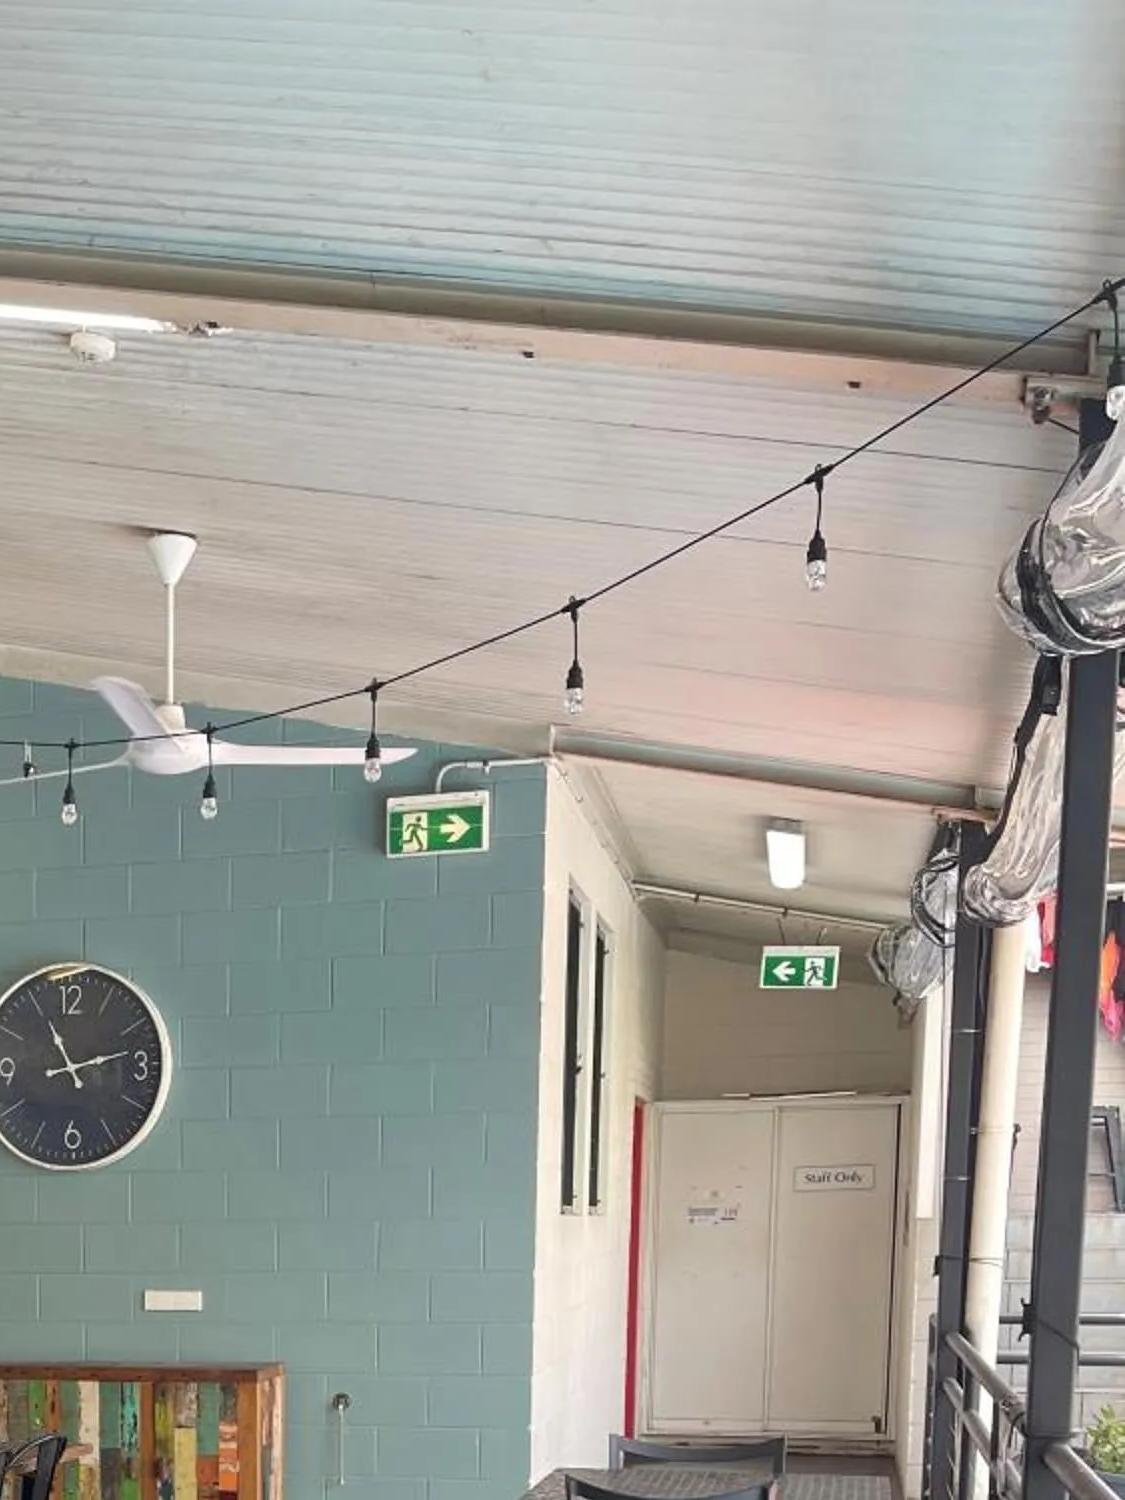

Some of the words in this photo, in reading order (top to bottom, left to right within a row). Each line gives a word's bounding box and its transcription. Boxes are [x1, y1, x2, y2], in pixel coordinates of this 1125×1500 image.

[59, 985, 83, 1015] 12
[134, 1051, 148, 1081] 3
[64, 1119, 82, 1149] 6
[804, 1171, 832, 1183] Staff
[834, 1170, 863, 1185] Only
